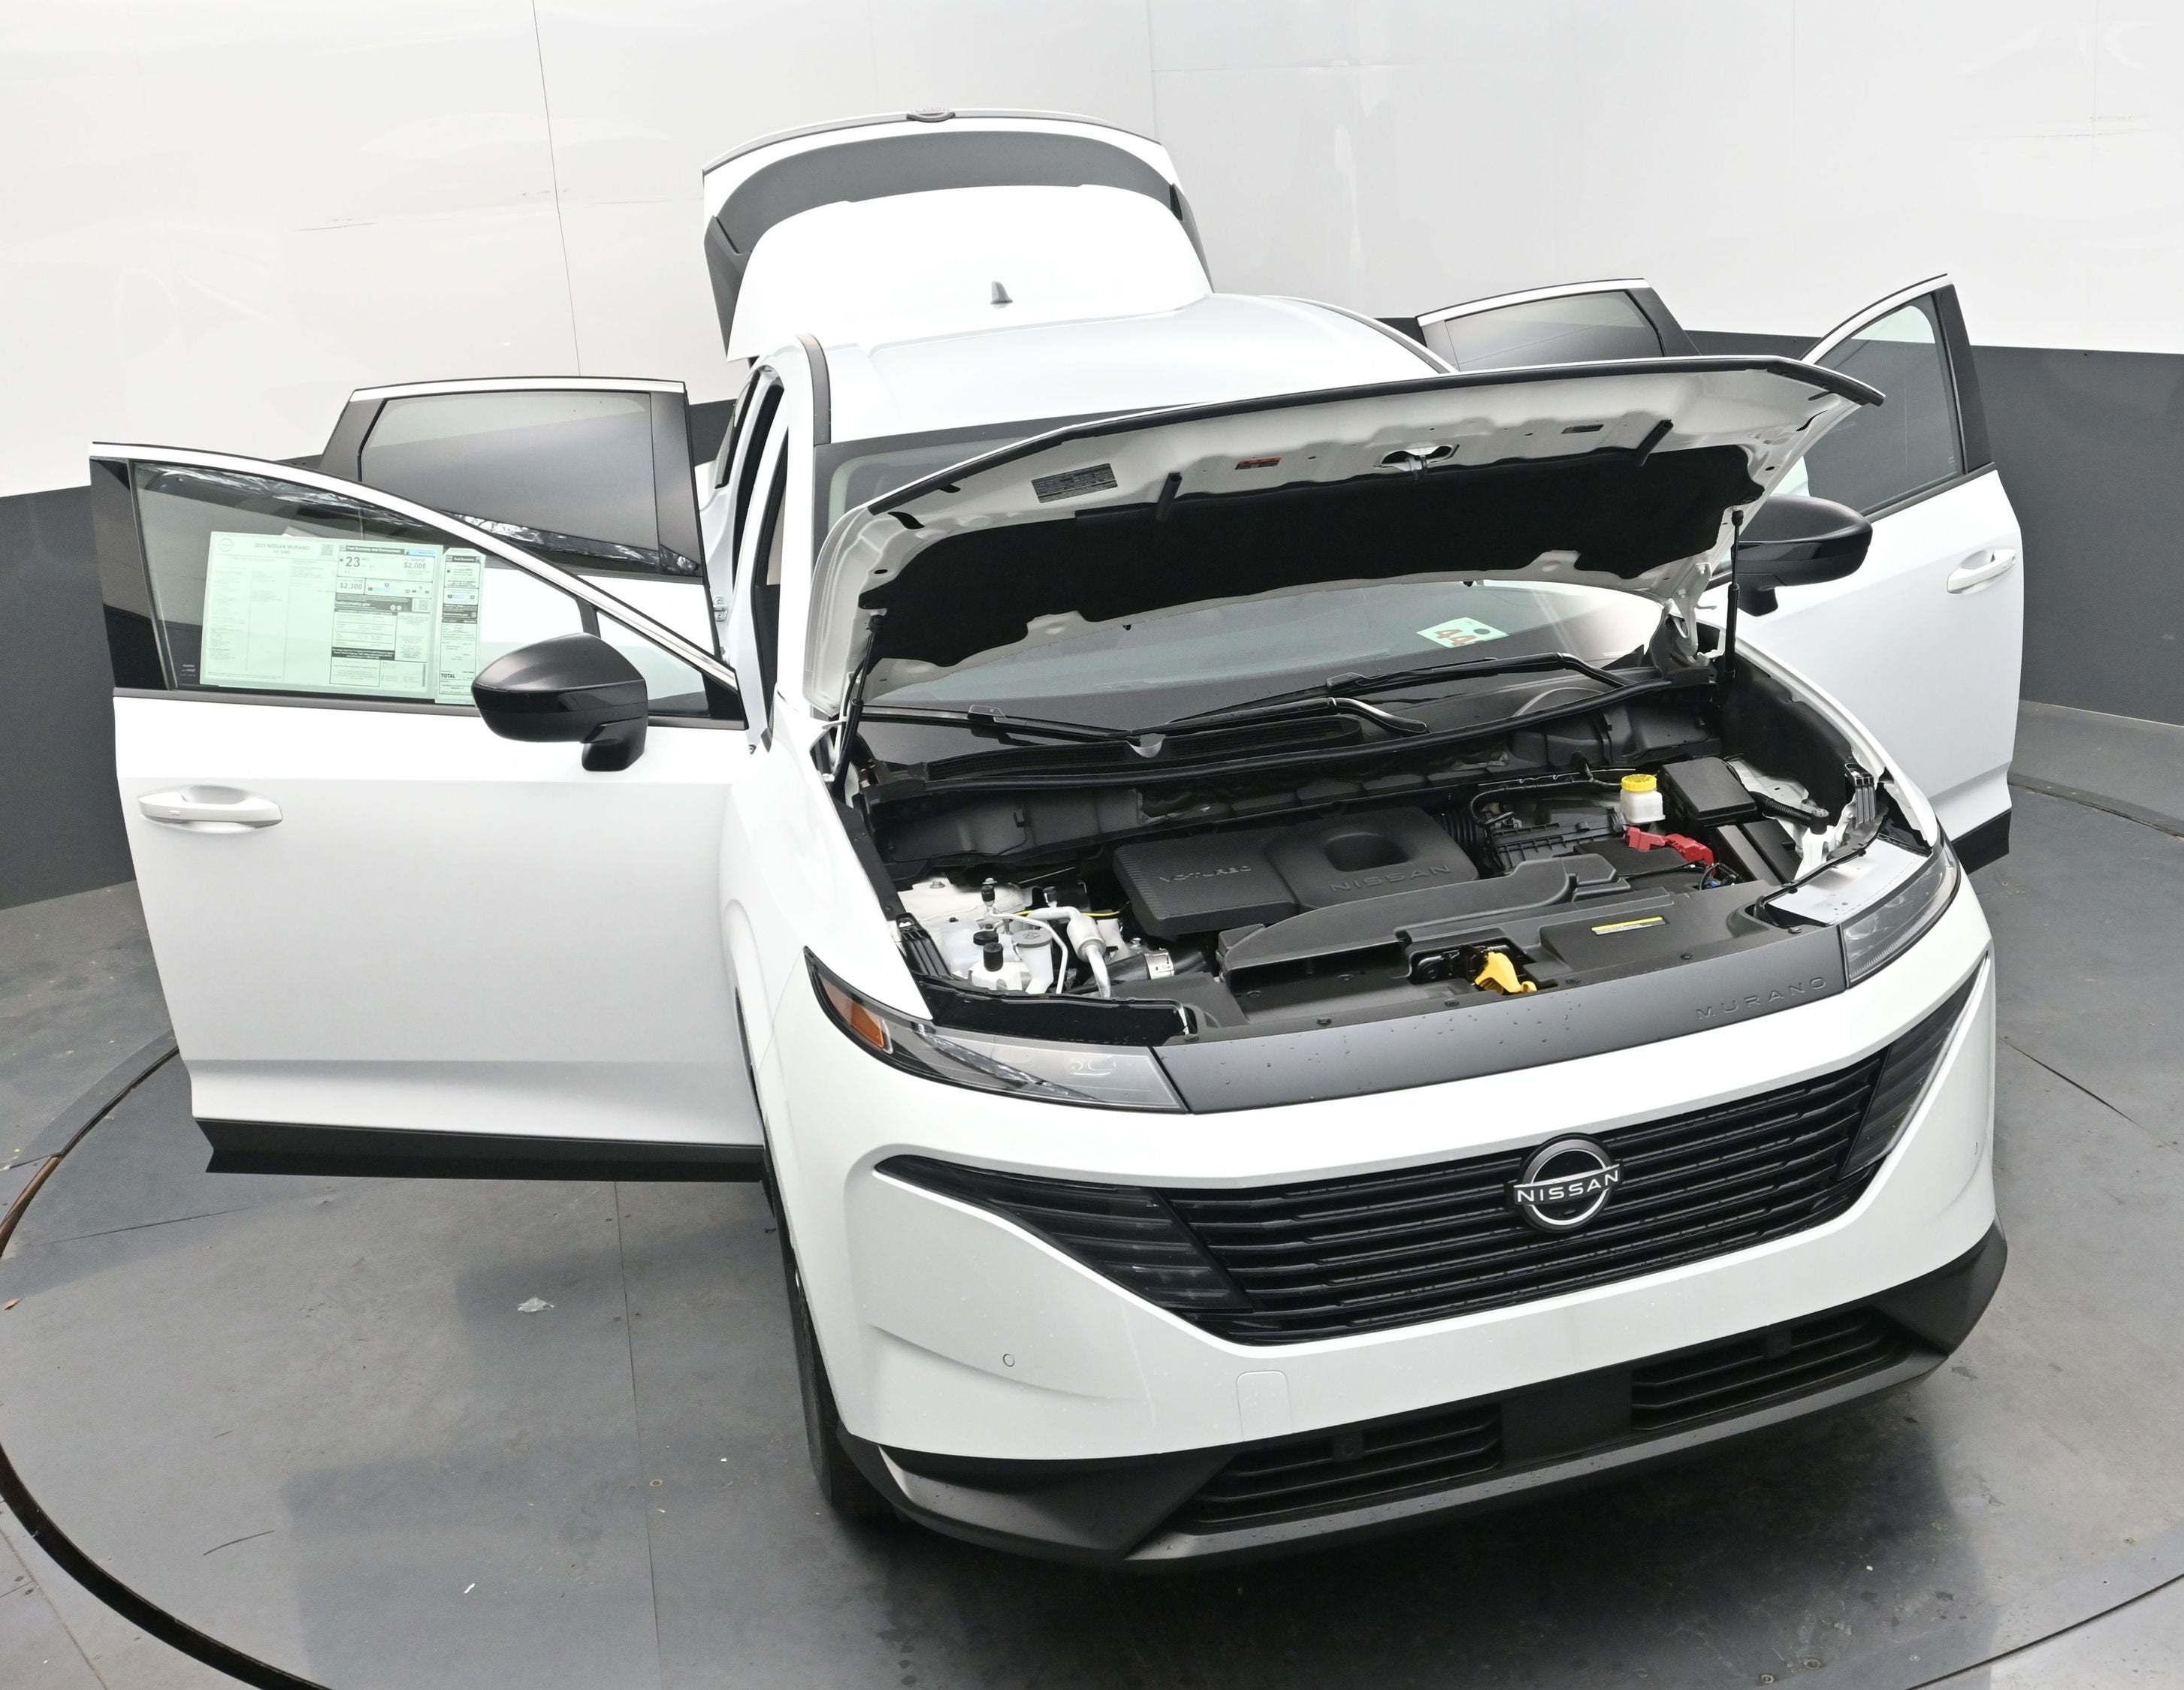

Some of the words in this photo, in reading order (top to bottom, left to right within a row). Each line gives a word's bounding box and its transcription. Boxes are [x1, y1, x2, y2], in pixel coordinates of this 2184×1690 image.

[346, 557, 360, 567] 23
[1329, 865, 1451, 892] NISSAN
[1696, 977, 1826, 1019] MURANO
[1517, 1169, 1619, 1203] NISSAN
